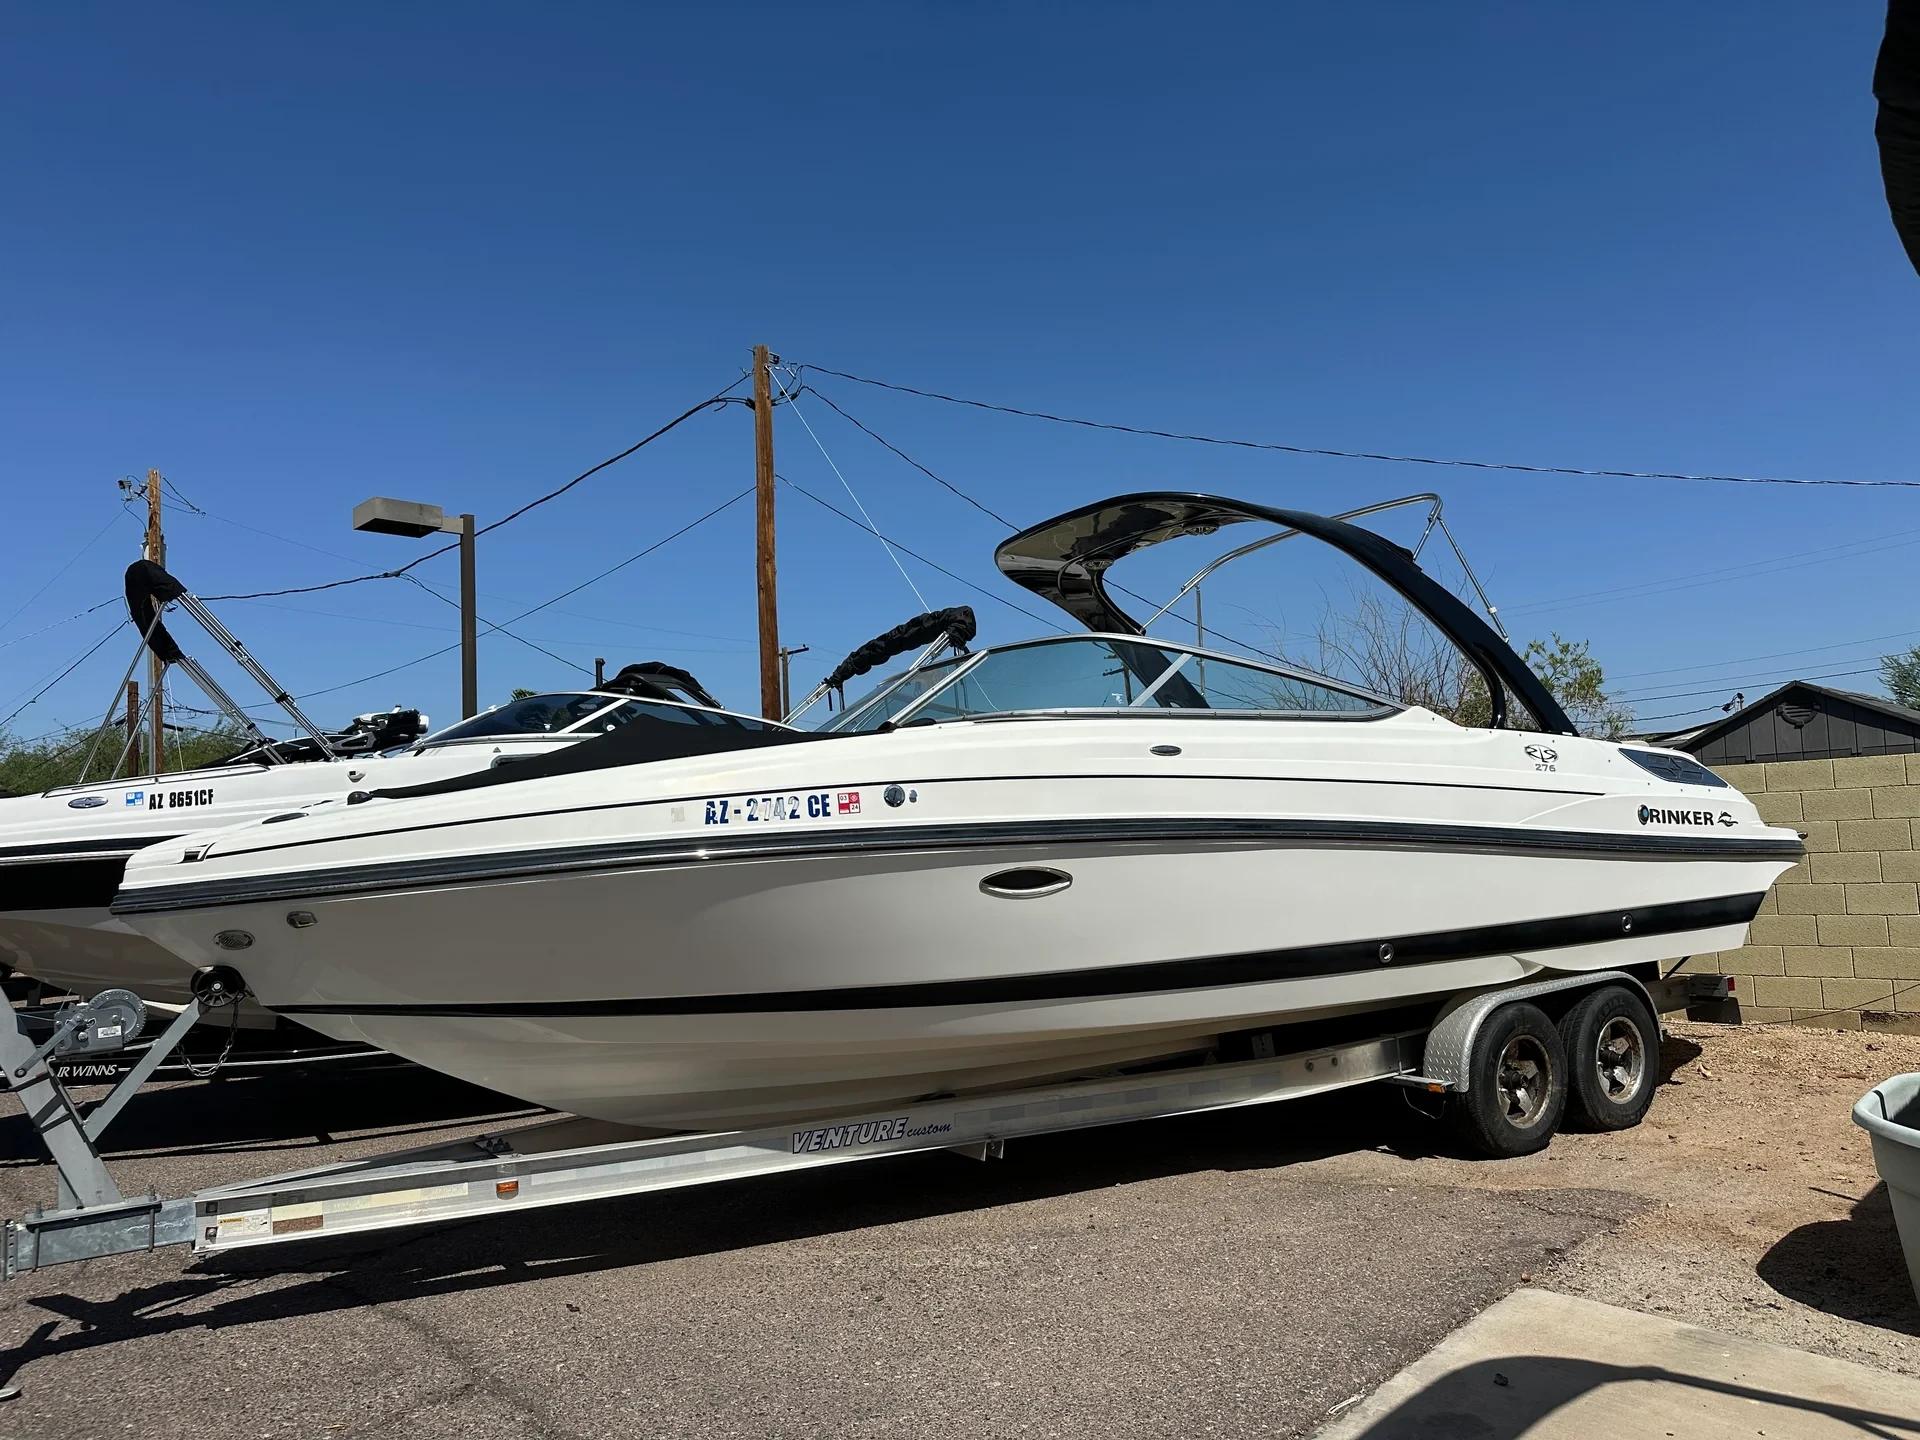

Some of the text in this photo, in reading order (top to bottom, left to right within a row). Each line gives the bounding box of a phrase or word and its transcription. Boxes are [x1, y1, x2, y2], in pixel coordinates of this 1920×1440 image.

[1535, 763, 1556, 772] 276
[149, 788, 214, 810] AZ 8651CF
[807, 794, 832, 818] CE
[1649, 808, 1714, 826] RINKER
[72, 1064, 118, 1077] WINNS
[792, 1117, 952, 1154] VENTURE custom
